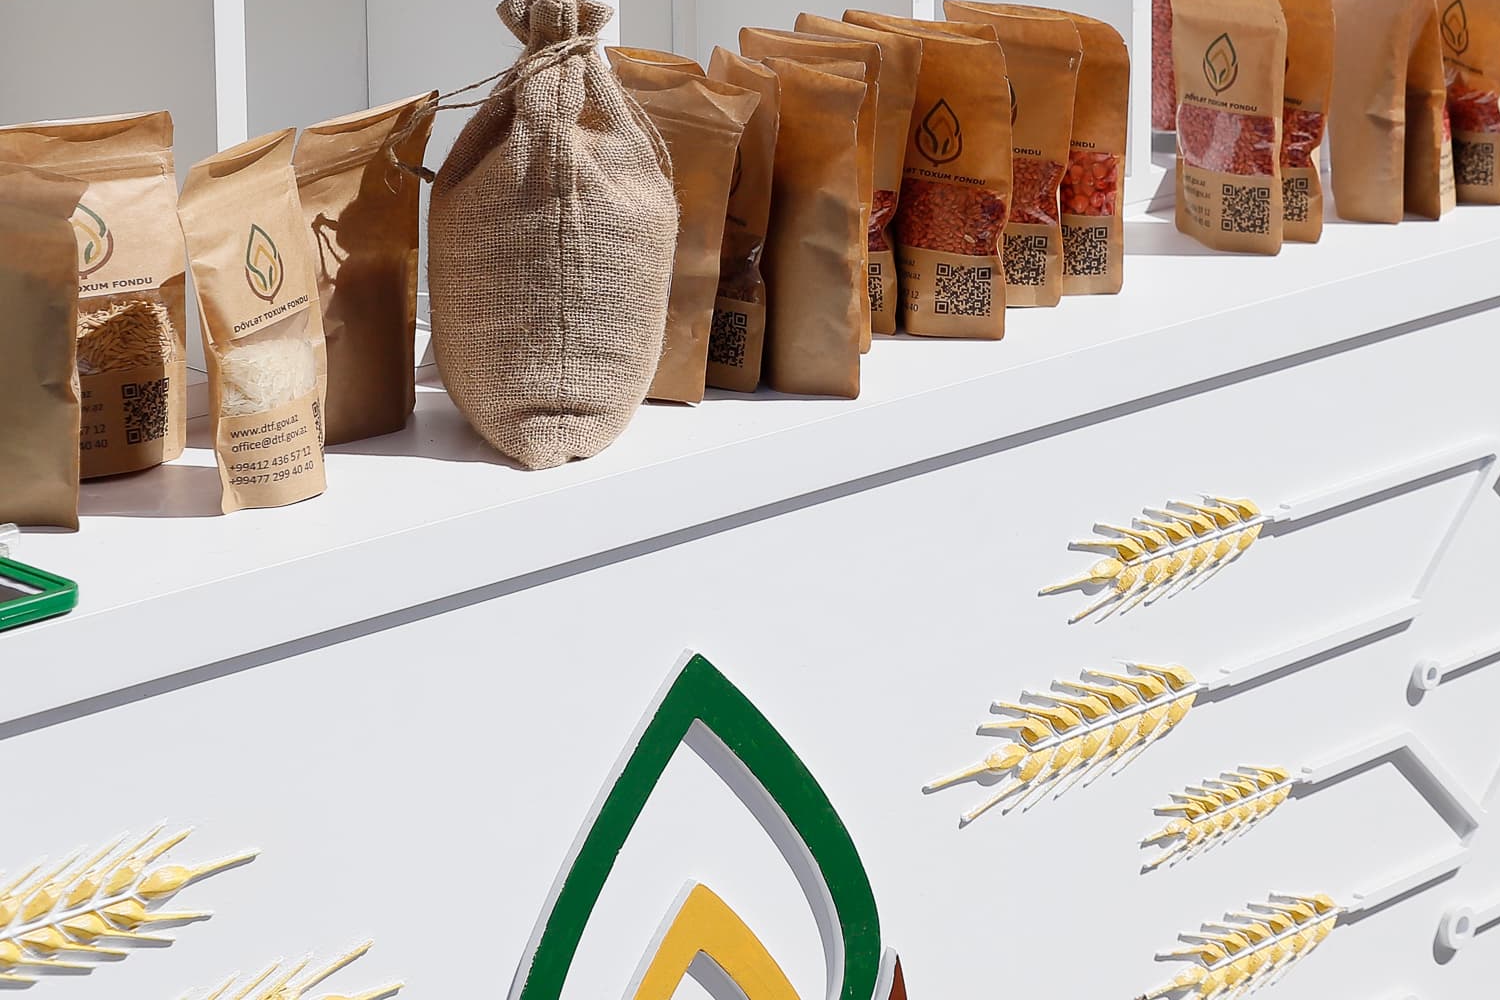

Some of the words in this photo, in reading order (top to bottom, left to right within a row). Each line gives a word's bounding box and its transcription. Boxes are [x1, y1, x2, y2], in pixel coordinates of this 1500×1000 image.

[1229, 103, 1257, 112] FONDU
[1013, 147, 1042, 156] ONDU
[1070, 140, 1096, 149] ONDU
[919, 169, 952, 181] TOXUM
[953, 175, 986, 186] FONDU
[79, 282, 109, 293] XUM
[112, 277, 153, 289] FONDU
[233, 315, 263, 333] DÖVLƏT
[263, 304, 287, 320] TOXUM
[287, 294, 309, 312] FONDU
[230, 414, 299, 439] www.dtf.gov.az
[231, 426, 308, 453] office@dtf.gov.az
[230, 459, 270, 473] +99412
[271, 454, 289, 469] 436
[290, 449, 300, 462] 57
[303, 445, 312, 457] 12
[230, 474, 270, 486] +99477
[272, 469, 290, 482] 299
[292, 464, 303, 476] 40
[304, 459, 314, 471] 40
